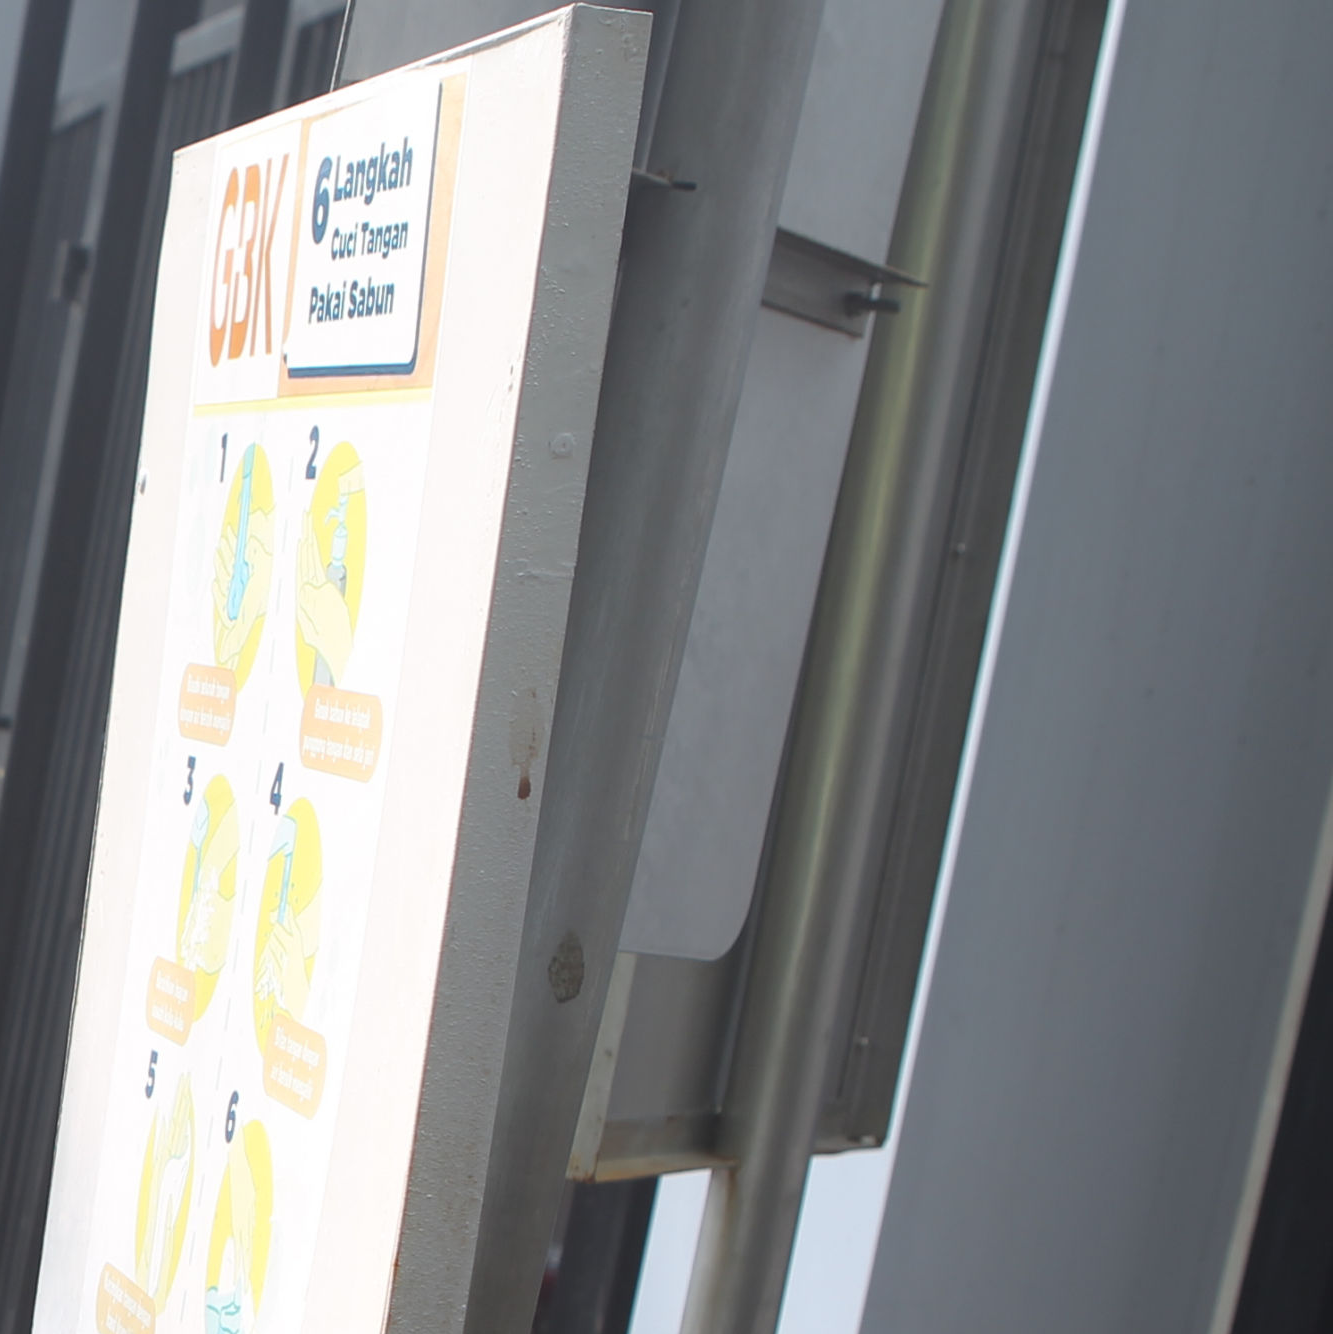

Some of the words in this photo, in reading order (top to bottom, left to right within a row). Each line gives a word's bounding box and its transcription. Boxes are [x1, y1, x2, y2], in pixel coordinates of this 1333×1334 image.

[311, 156, 333, 244] 6
[333, 136, 413, 206] Langkah
[209, 153, 290, 367] GBK
[331, 222, 358, 261] Cuci
[361, 221, 409, 260] Tangan
[308, 280, 347, 324] Pakai
[347, 276, 395, 319] Sabun
[220, 432, 228, 483] 1
[305, 425, 320, 479] 2
[183, 755, 196, 806] 3
[270, 762, 284, 816] 4
[145, 1050, 159, 1099] 5
[225, 1090, 239, 1143] 6
